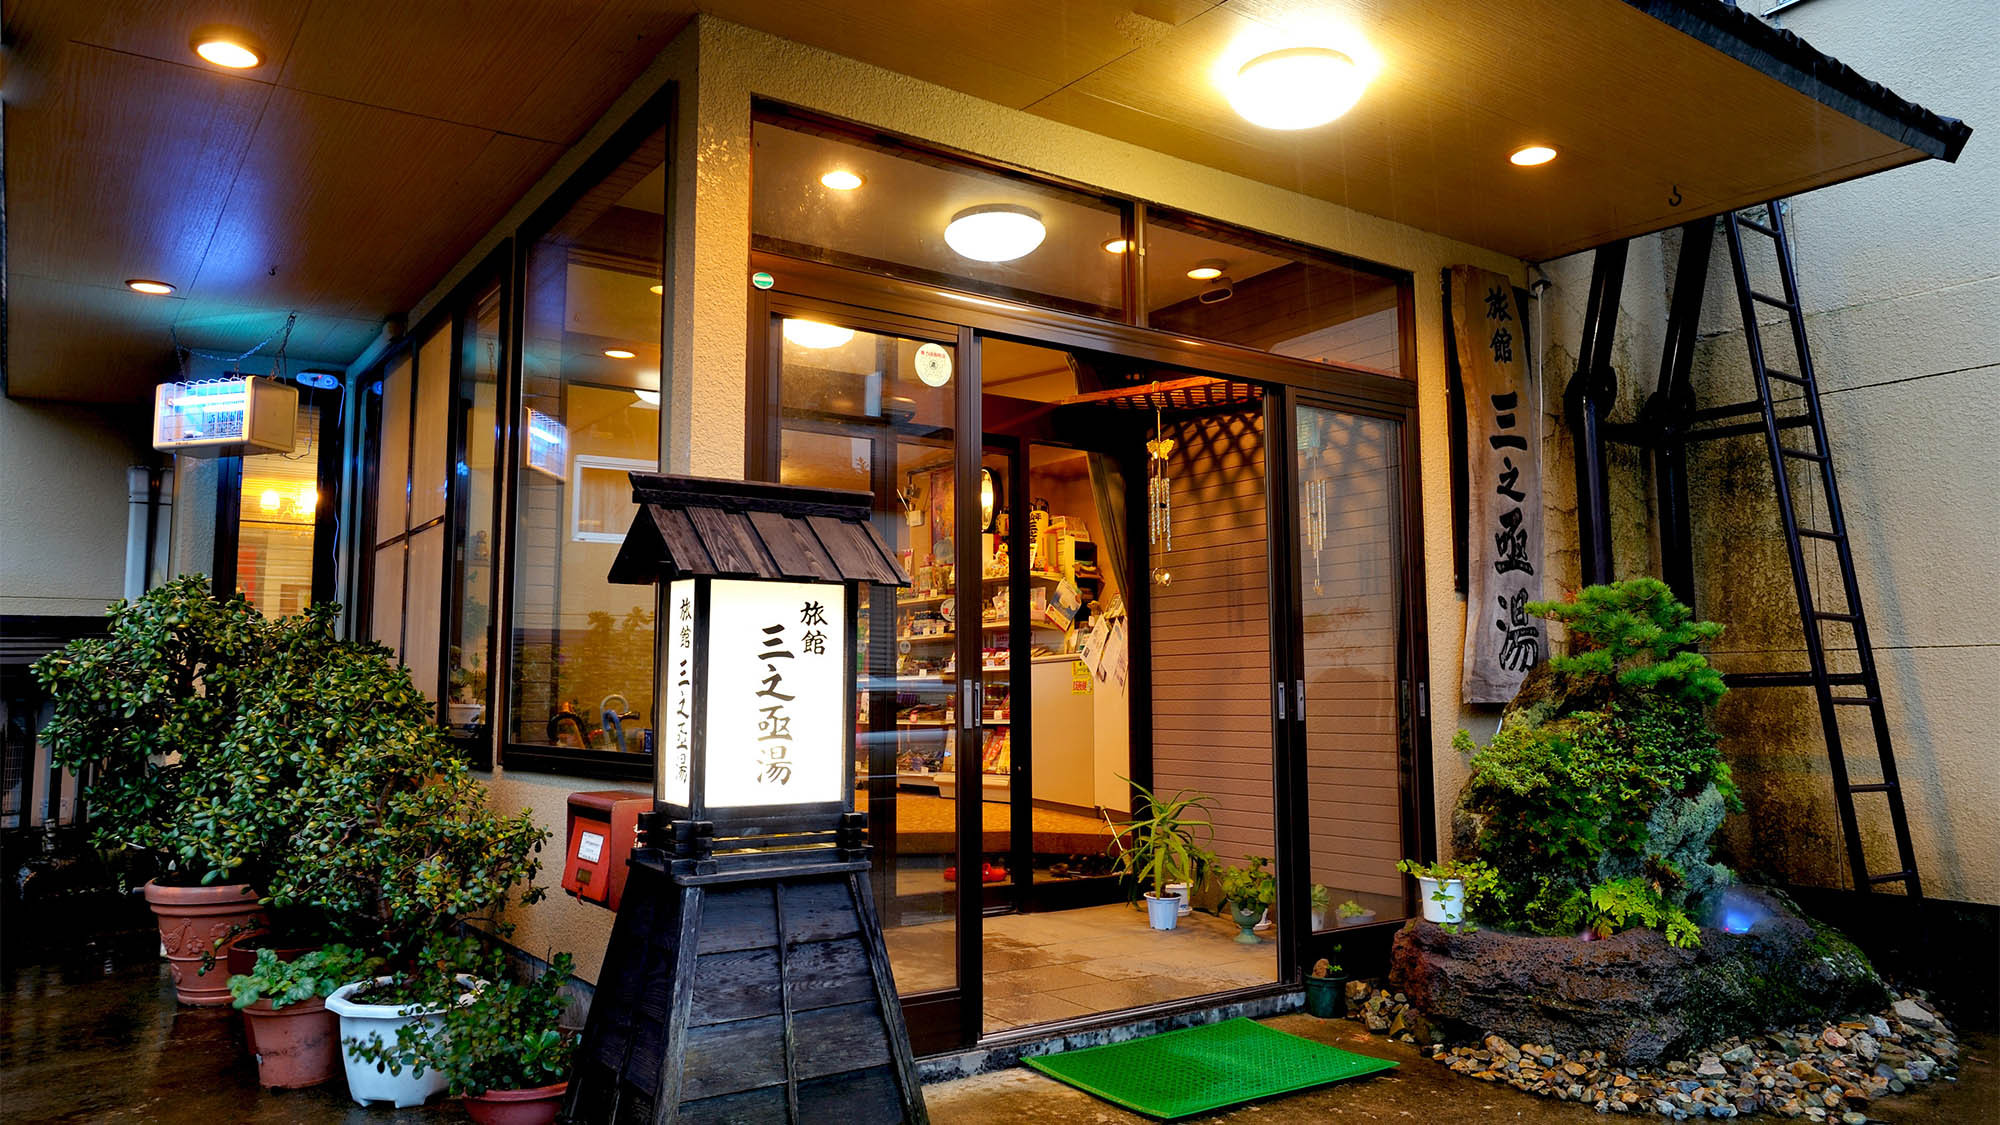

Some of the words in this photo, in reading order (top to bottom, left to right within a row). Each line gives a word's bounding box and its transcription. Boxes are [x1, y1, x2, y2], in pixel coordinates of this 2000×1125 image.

[1484, 285, 1513, 364] 旅館
[679, 597, 692, 649] 旅館
[800, 600, 828, 656] 旅館
